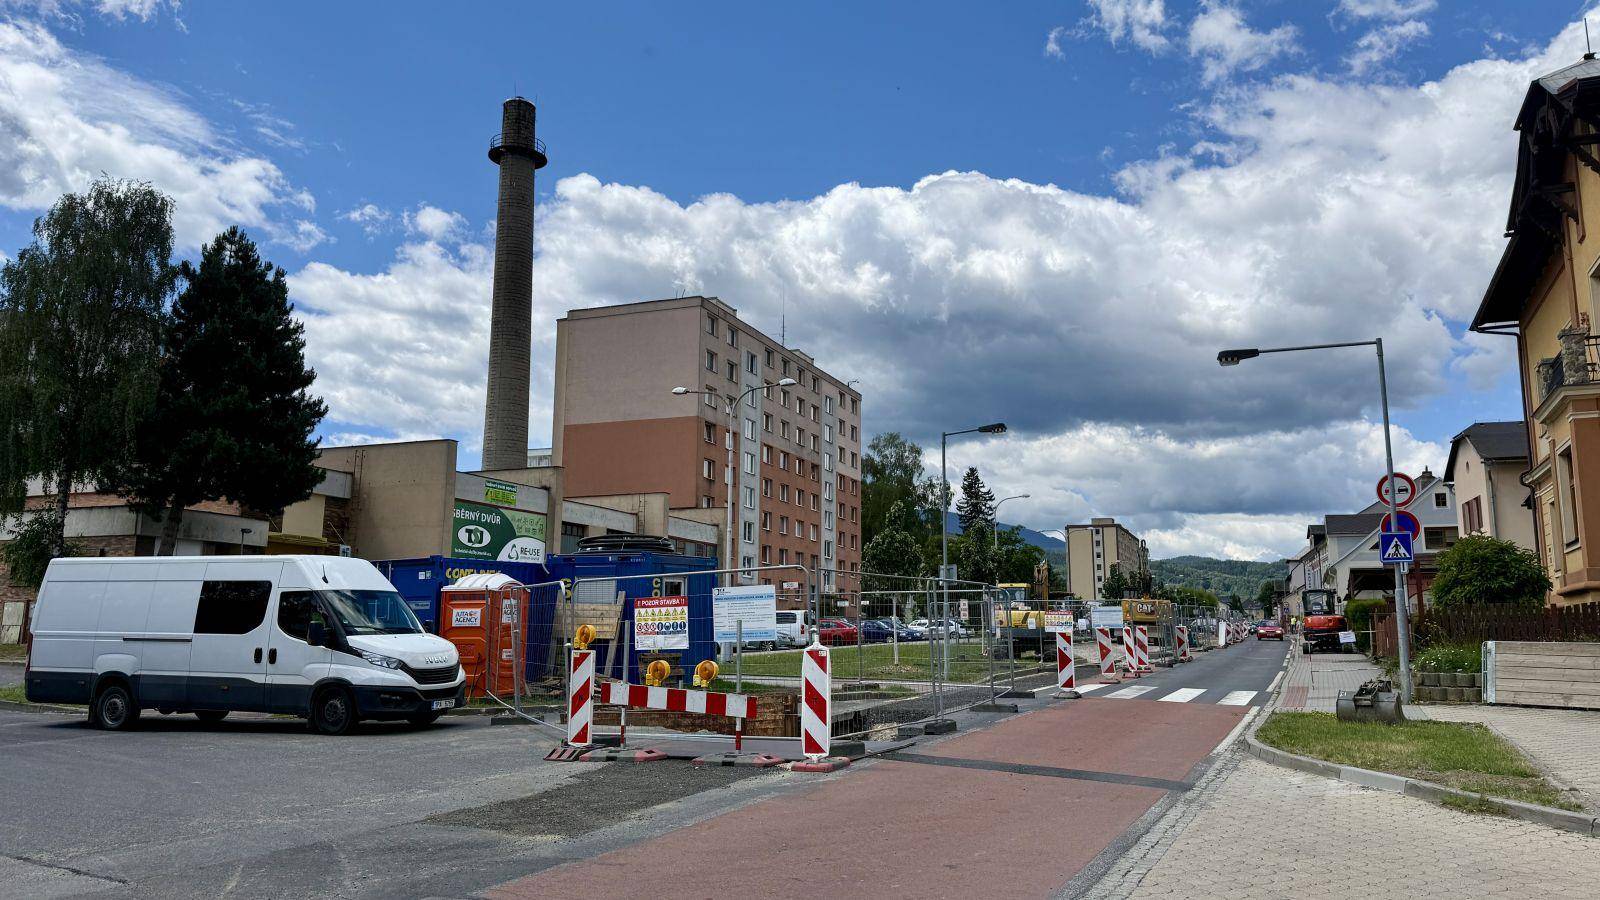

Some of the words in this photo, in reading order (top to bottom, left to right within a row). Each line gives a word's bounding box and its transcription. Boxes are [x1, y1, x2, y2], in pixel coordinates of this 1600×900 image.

[481, 513, 501, 525] DVŮR
[520, 547, 540, 557] RE-USE
[659, 598, 680, 606] STAVBA
[1137, 603, 1152, 613] CAT
